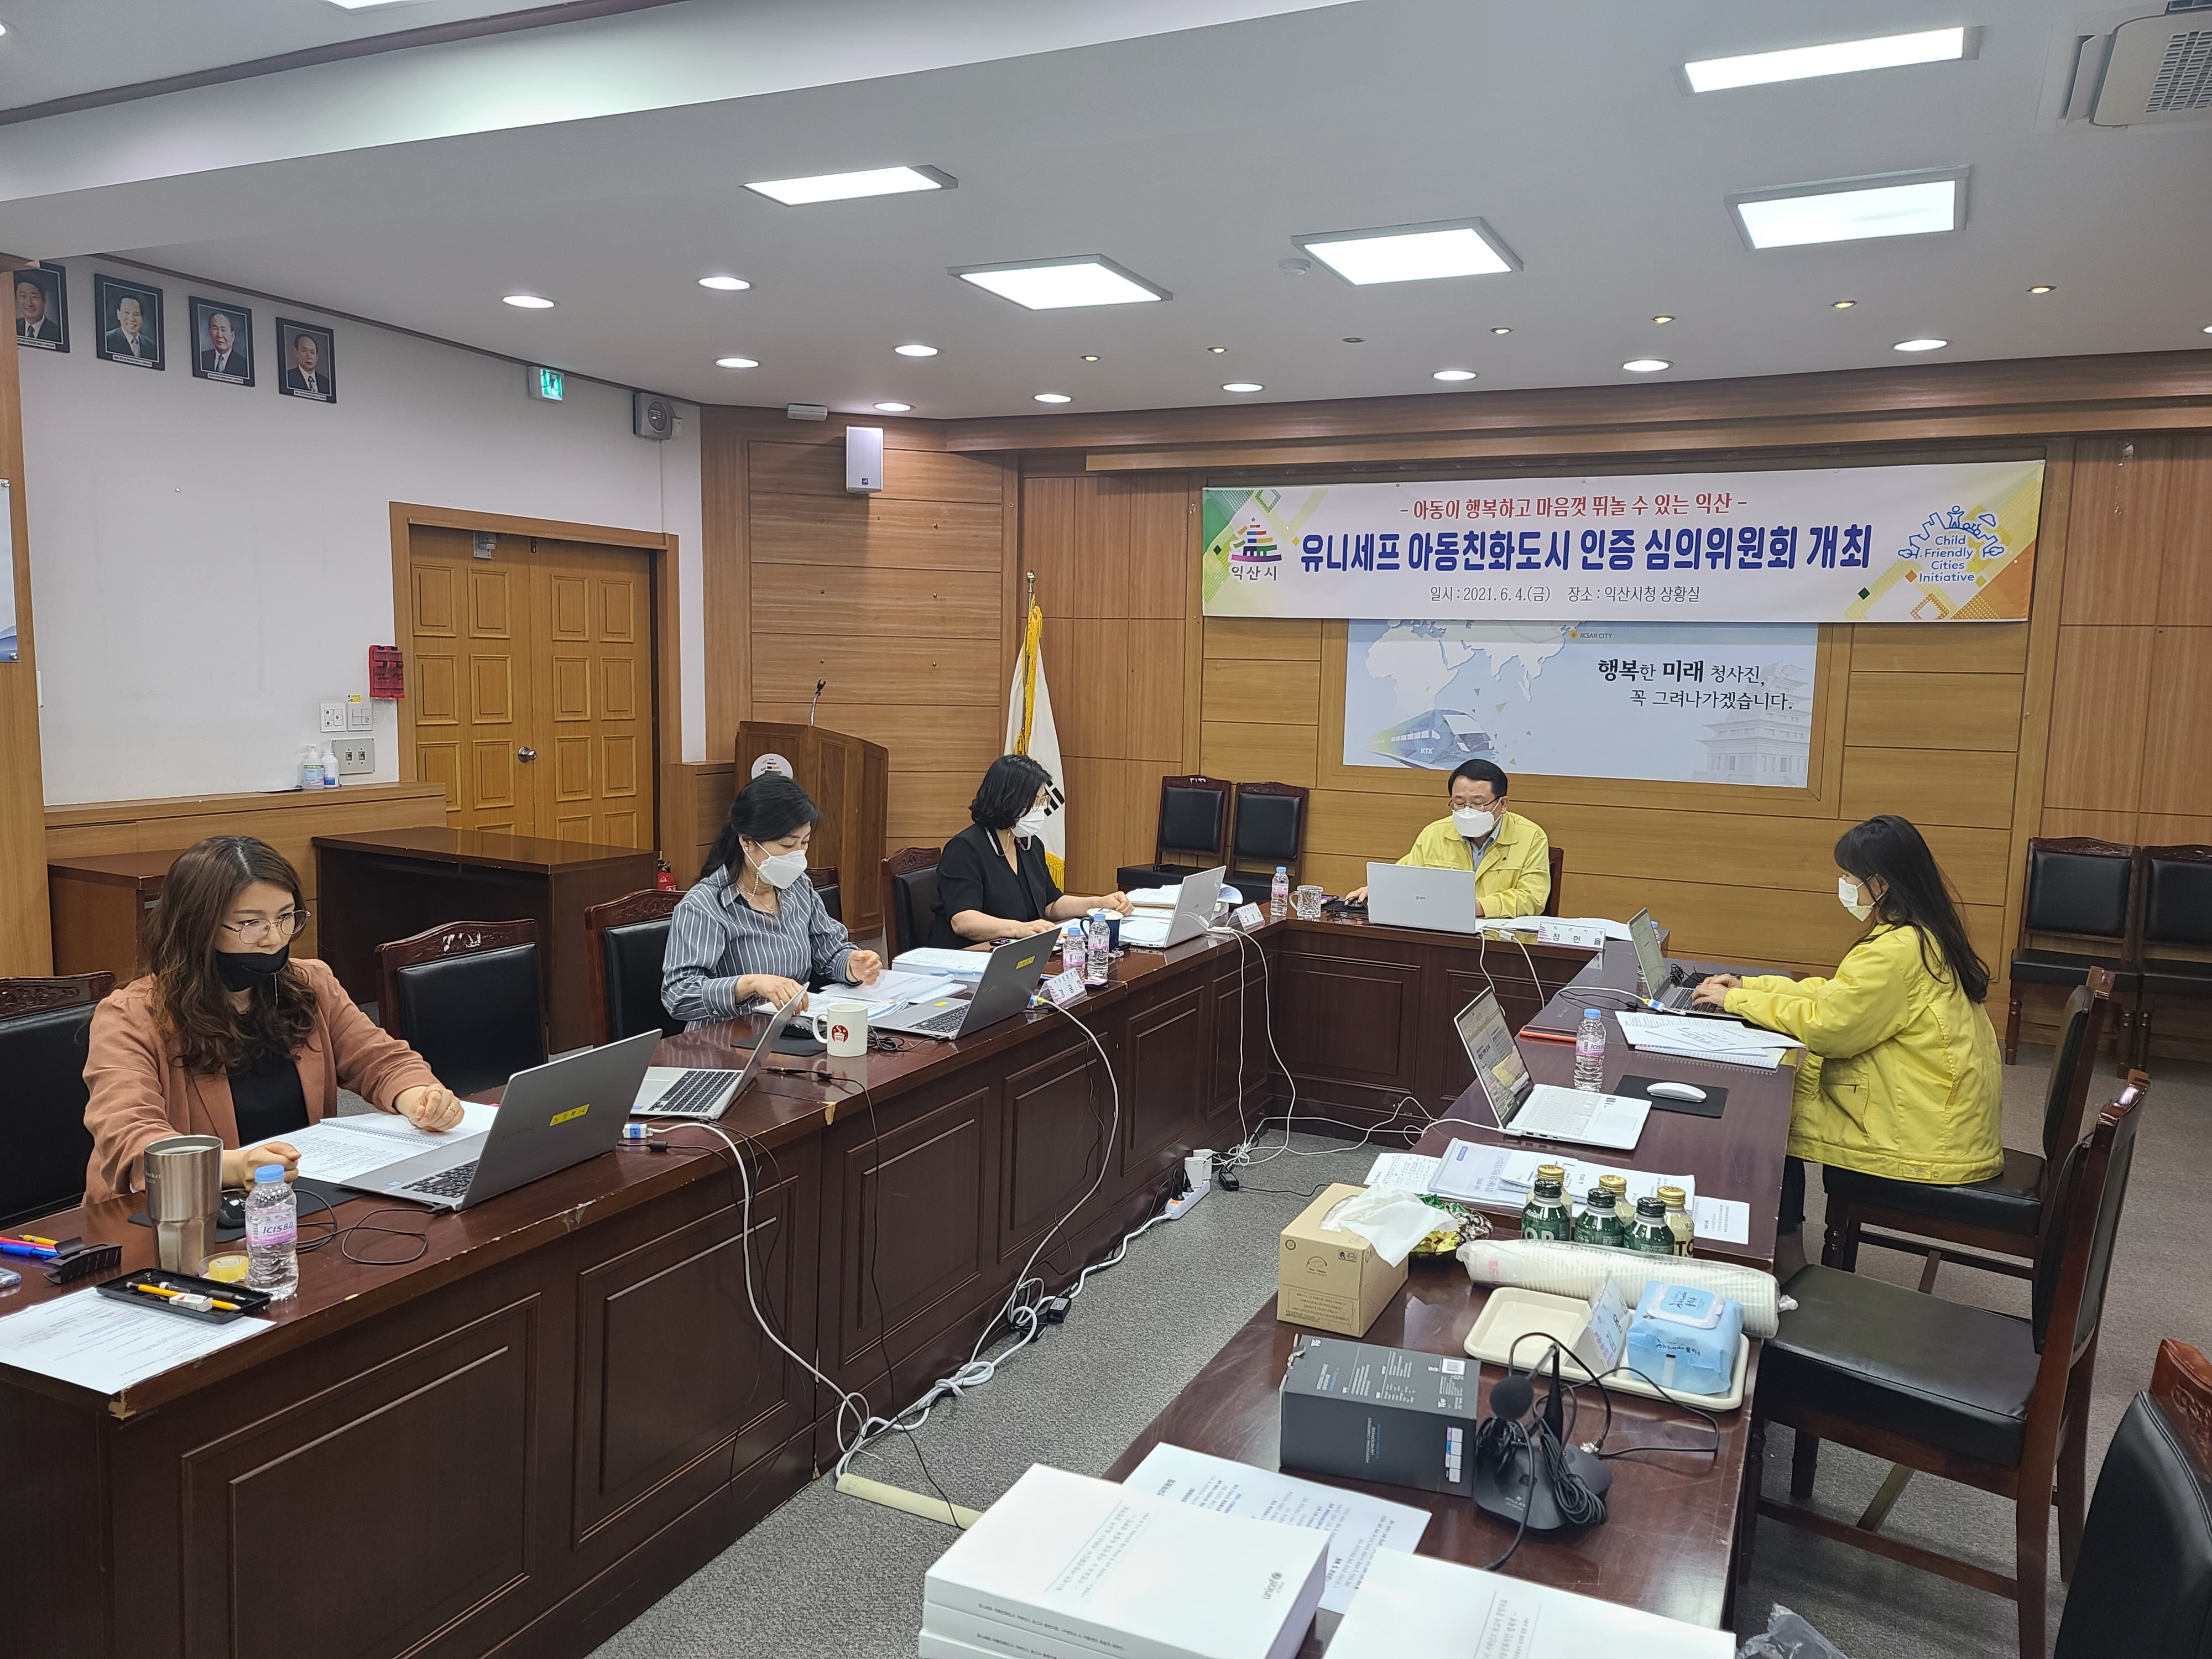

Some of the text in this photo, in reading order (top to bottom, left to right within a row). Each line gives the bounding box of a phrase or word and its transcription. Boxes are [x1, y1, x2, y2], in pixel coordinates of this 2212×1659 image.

[1413, 499, 1460, 520] 아동이
[1465, 498, 1531, 519] 행복하고
[1536, 496, 1587, 518] 마음껏
[1592, 495, 1626, 517] 뛰놀
[1631, 494, 1649, 515] 수
[1654, 494, 1689, 515] 있는
[1695, 492, 1733, 514] 익산
[1300, 523, 1872, 573] 유니세프 아동친화도시 인증 심의위원회 개최
[1934, 534, 1966, 546] Child
[1924, 547, 1974, 560] Friendly
[1230, 565, 1278, 581] 익산시
[1931, 560, 1965, 570] Cities
[1919, 571, 1975, 582] Initiative
[1604, 586, 1656, 603] 익산시청
[1660, 586, 1700, 603] 상황실
[1597, 659, 1765, 687] 행복한 미래 청사진,
[1629, 690, 1793, 712] 꼭 그려나가겠습니다.
